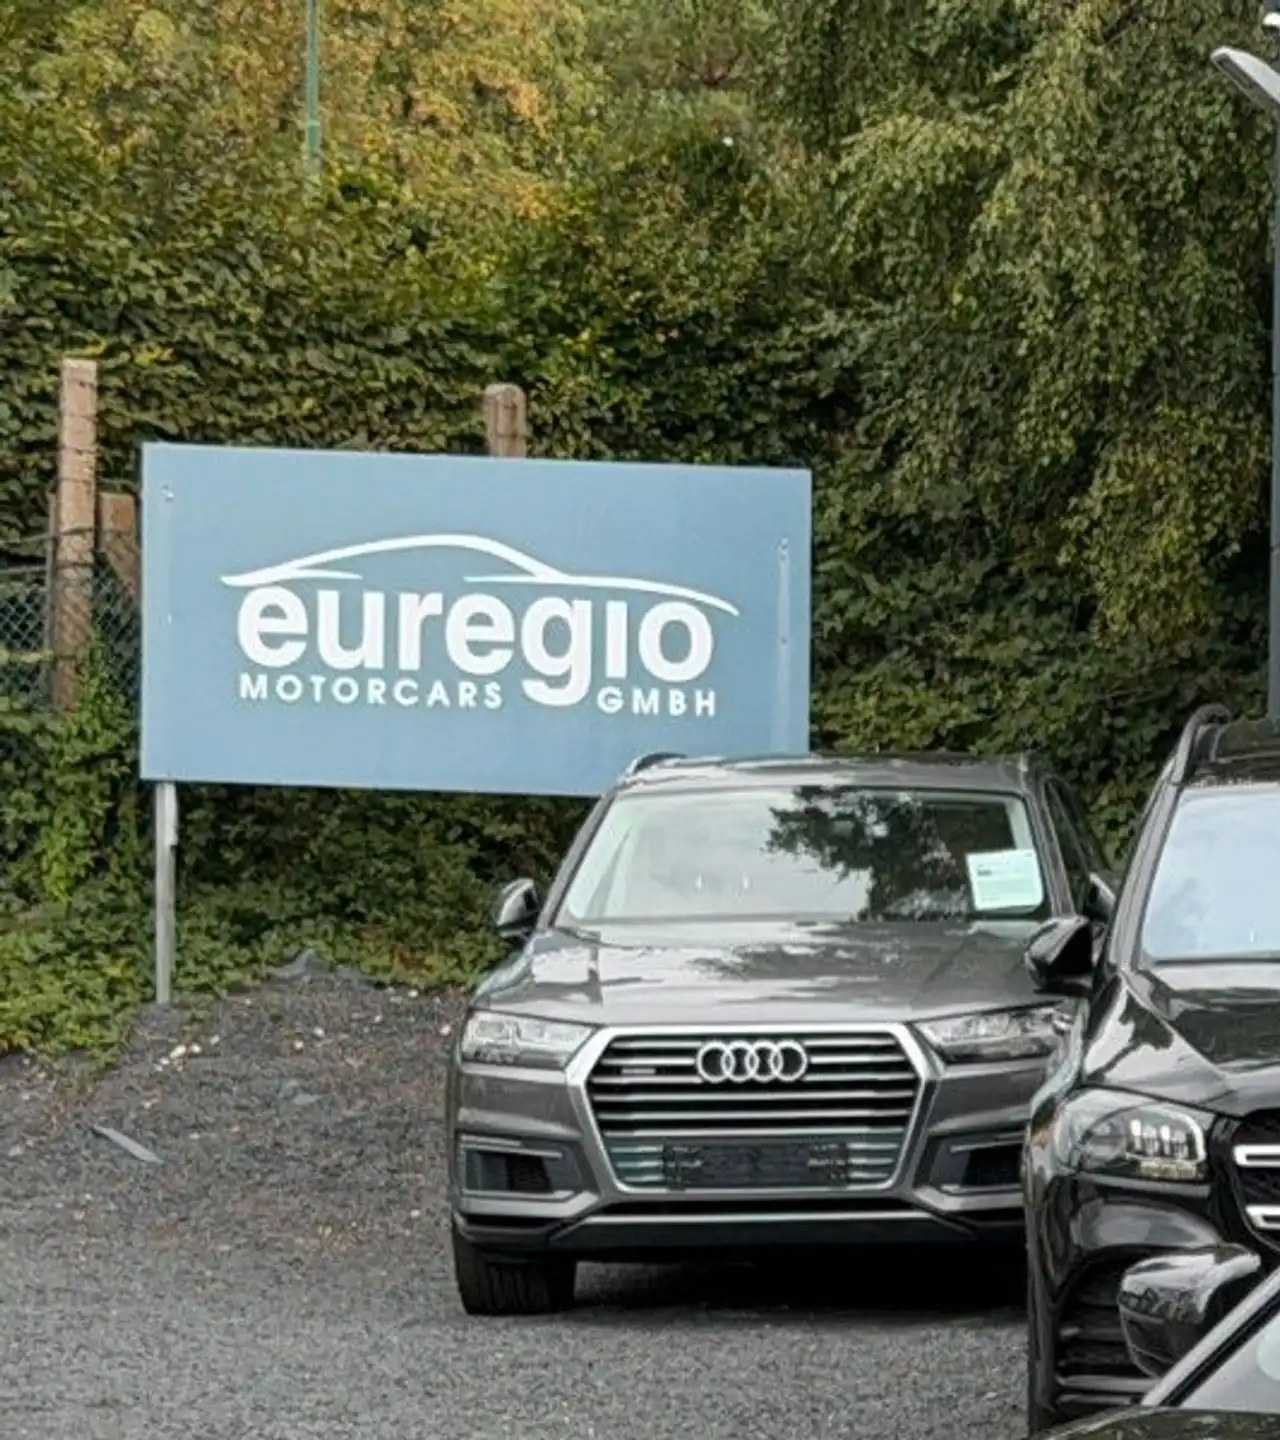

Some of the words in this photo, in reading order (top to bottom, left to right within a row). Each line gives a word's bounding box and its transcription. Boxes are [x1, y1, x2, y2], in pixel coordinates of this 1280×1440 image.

[237, 585, 714, 706] euregio
[239, 673, 502, 709] MOTORCARS
[597, 685, 716, 717] GMBH
